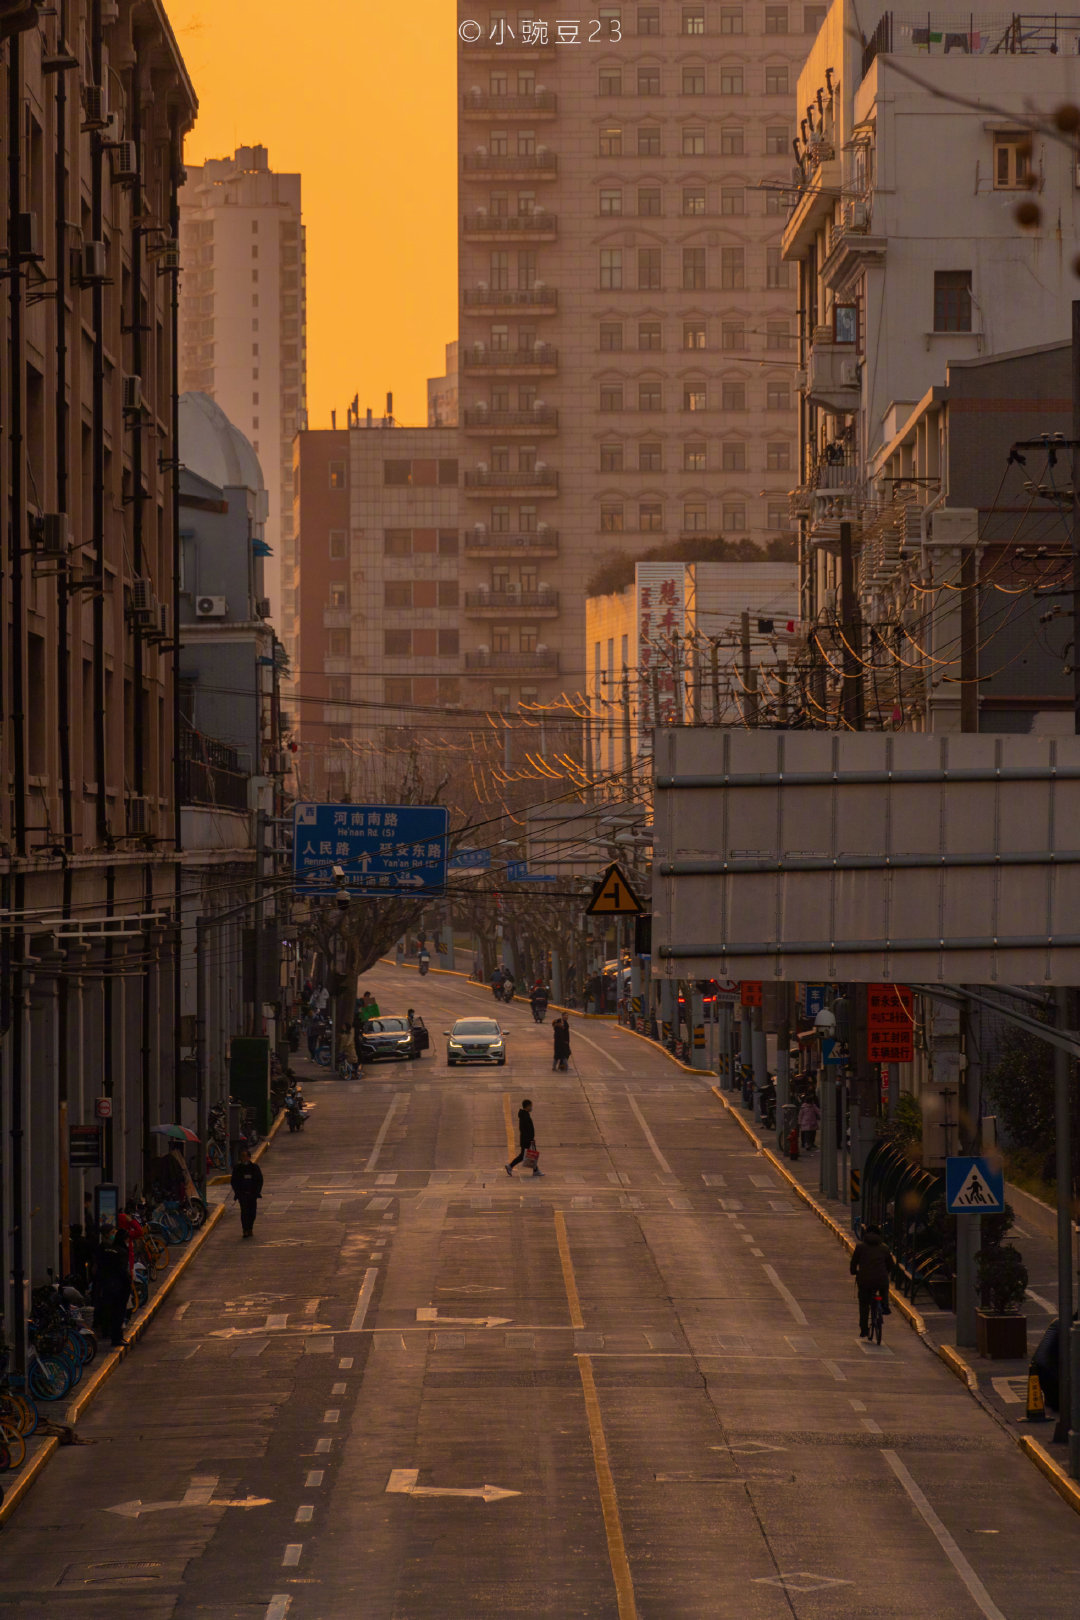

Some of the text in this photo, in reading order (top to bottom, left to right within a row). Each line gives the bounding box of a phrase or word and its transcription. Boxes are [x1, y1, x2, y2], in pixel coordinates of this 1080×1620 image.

[334, 811, 398, 826] 河南南路
[338, 827, 364, 837] He'nan
[302, 841, 350, 856] 人民路
[380, 842, 441, 858] 延安东路
[383, 859, 409, 868] Yan'an
